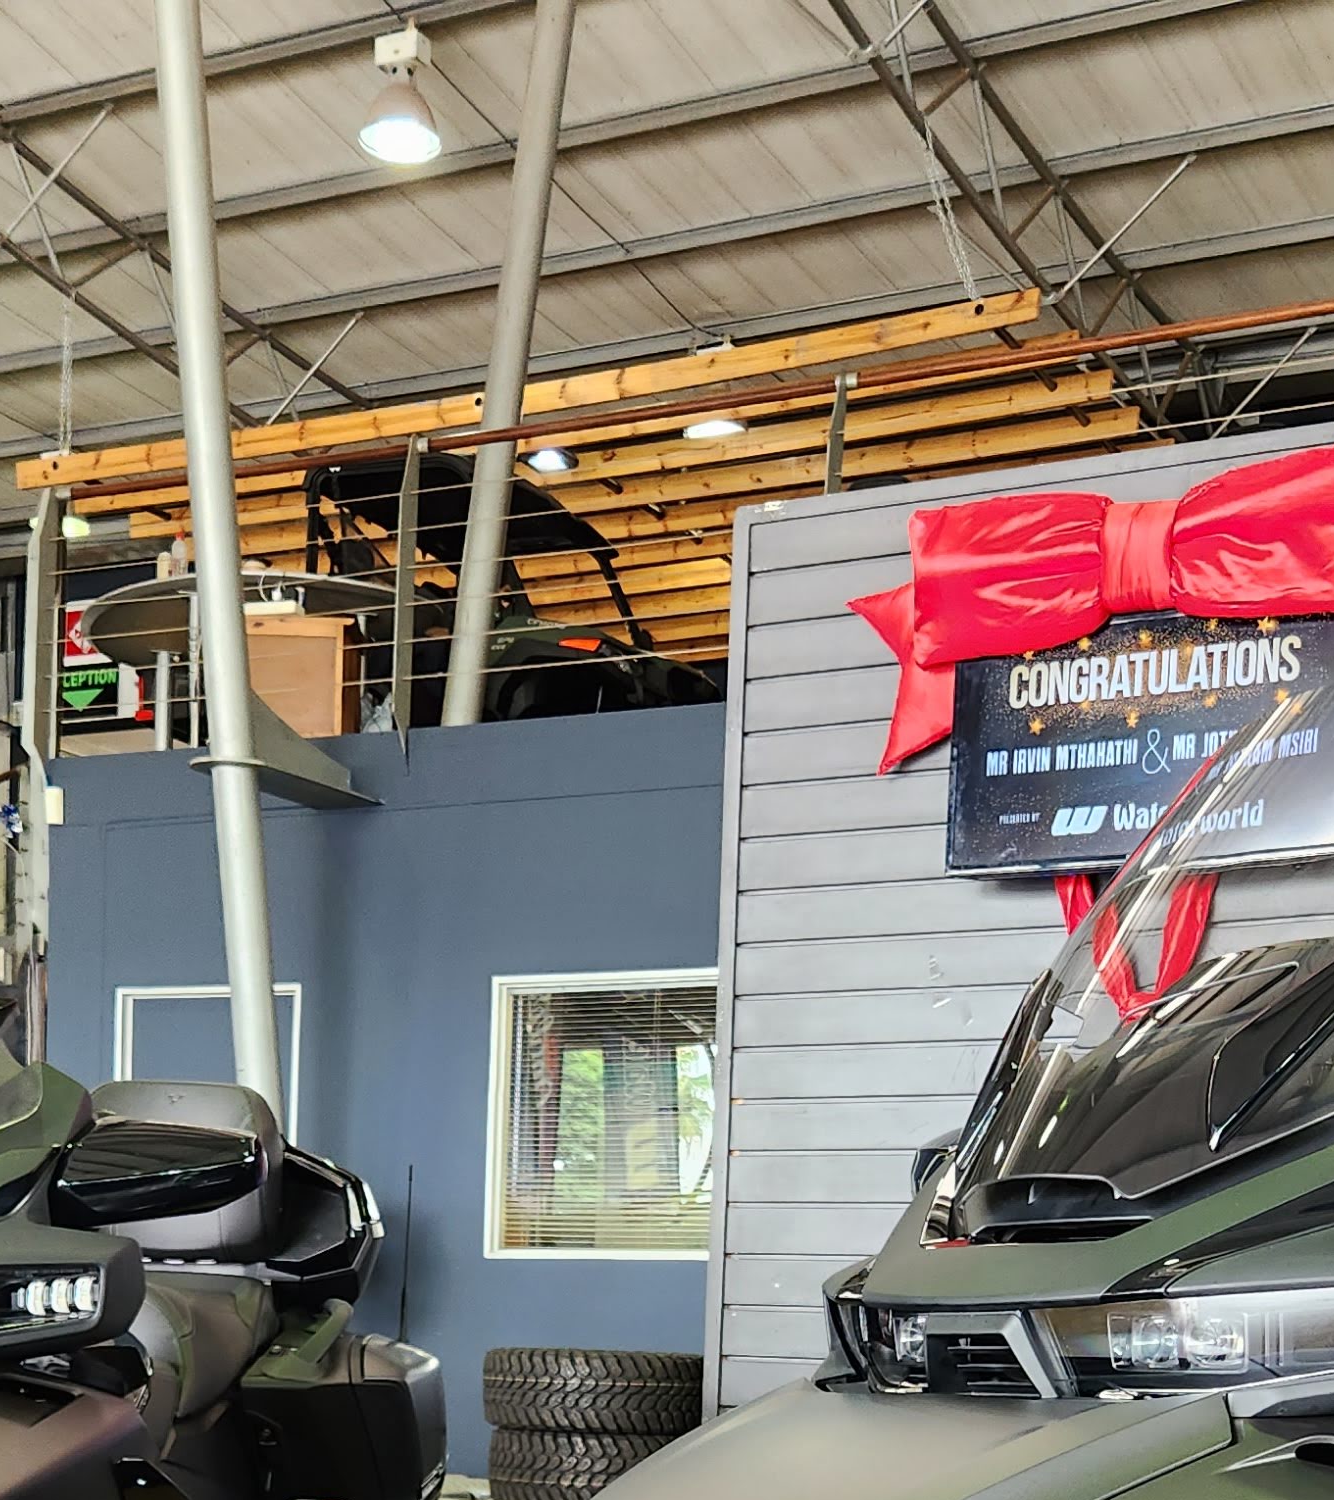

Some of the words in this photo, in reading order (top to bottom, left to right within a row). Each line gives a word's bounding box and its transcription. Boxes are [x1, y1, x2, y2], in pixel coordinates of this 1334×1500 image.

[62, 668, 117, 687] CEPTION
[1009, 635, 1302, 710] CONGRATULATIONS
[986, 751, 1009, 777] MR
[1012, 747, 1051, 775] IRVIN
[1142, 728, 1171, 774] &
[1172, 734, 1195, 760] MR
[1277, 727, 1319, 759] MSIBI
